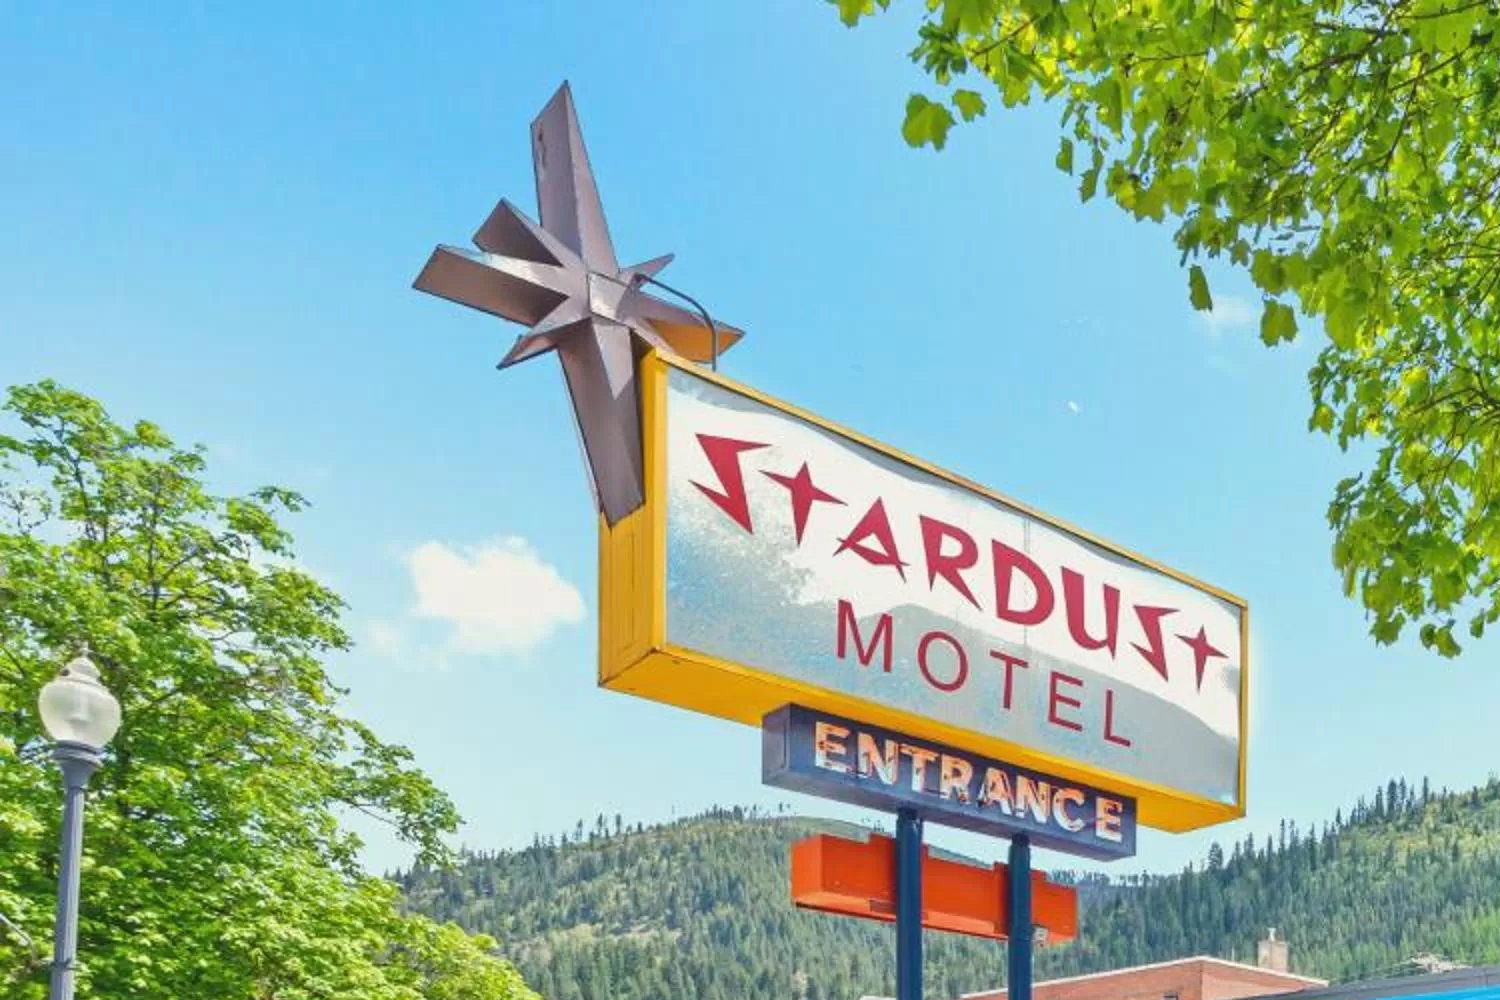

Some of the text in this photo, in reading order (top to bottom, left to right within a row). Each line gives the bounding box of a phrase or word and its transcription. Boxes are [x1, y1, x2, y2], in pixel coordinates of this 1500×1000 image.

[688, 433, 1229, 692] STARDUST
[836, 600, 1132, 748] MOTEL
[814, 720, 1124, 844] ENTRANCE
